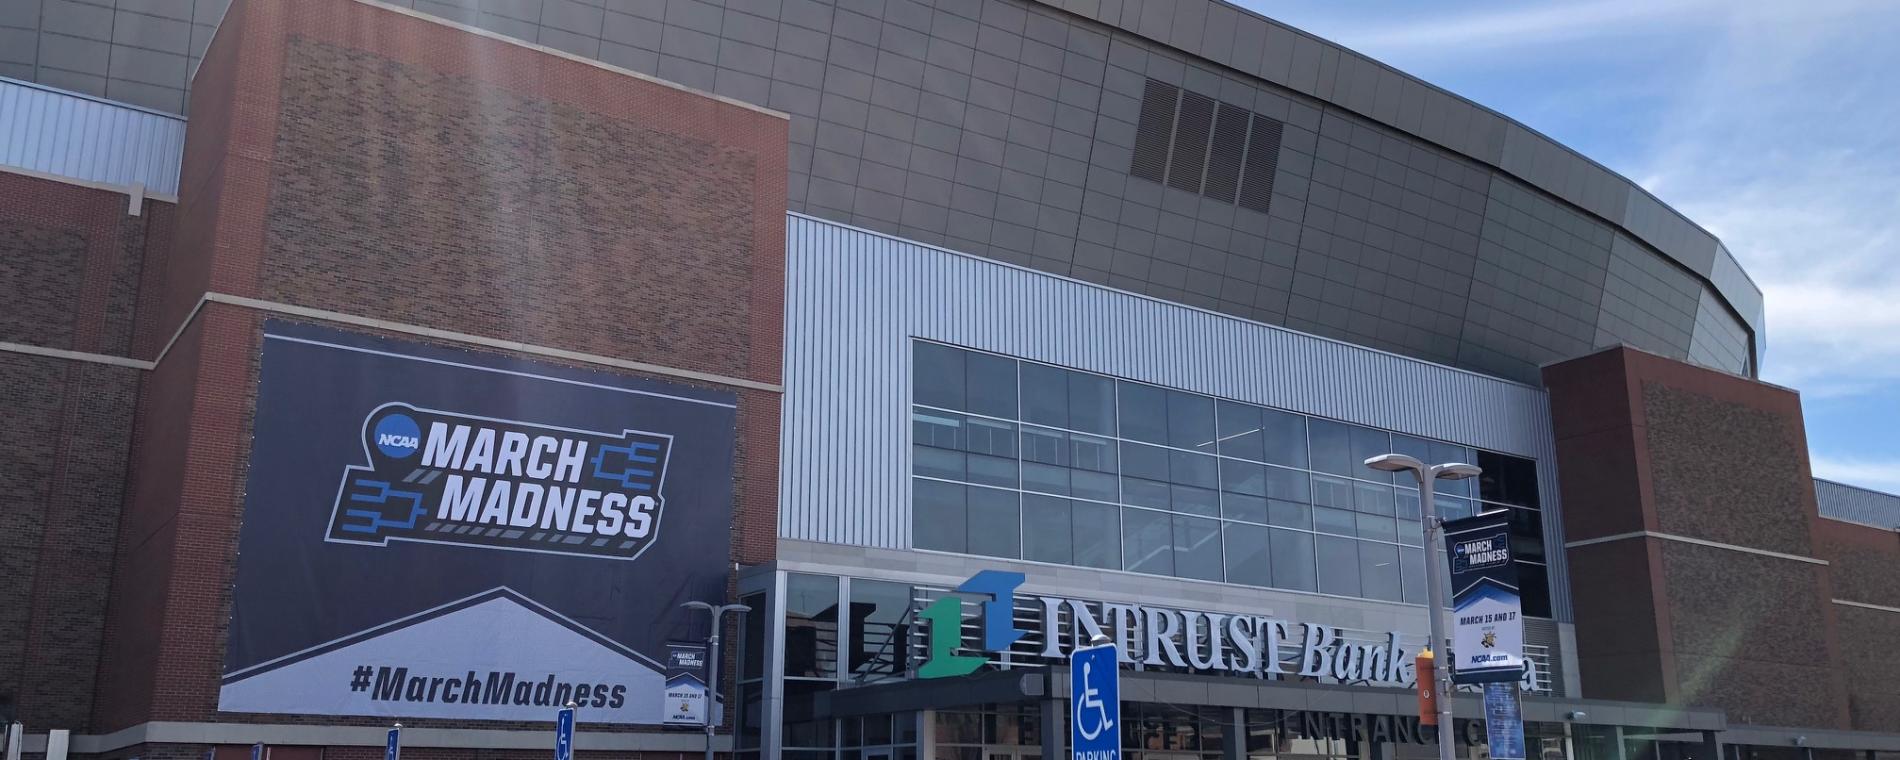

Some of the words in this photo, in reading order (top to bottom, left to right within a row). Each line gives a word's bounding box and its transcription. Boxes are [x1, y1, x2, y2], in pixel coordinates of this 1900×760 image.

[379, 433, 419, 449] NCAA
[421, 421, 588, 483] MARCH
[437, 474, 656, 538] MADNESS
[1465, 540, 1492, 554] MARCH
[1470, 549, 1507, 565] MADNESS
[1460, 616, 1484, 625] MARCH
[1485, 614, 1493, 623] 15
[1494, 612, 1508, 622] AND
[1509, 611, 1516, 621] 17
[1039, 597, 1289, 674] INTRUST
[1297, 622, 1416, 683] Bank
[1471, 654, 1508, 664] NCAA.com
[350, 665, 627, 709] #MarchMadness
